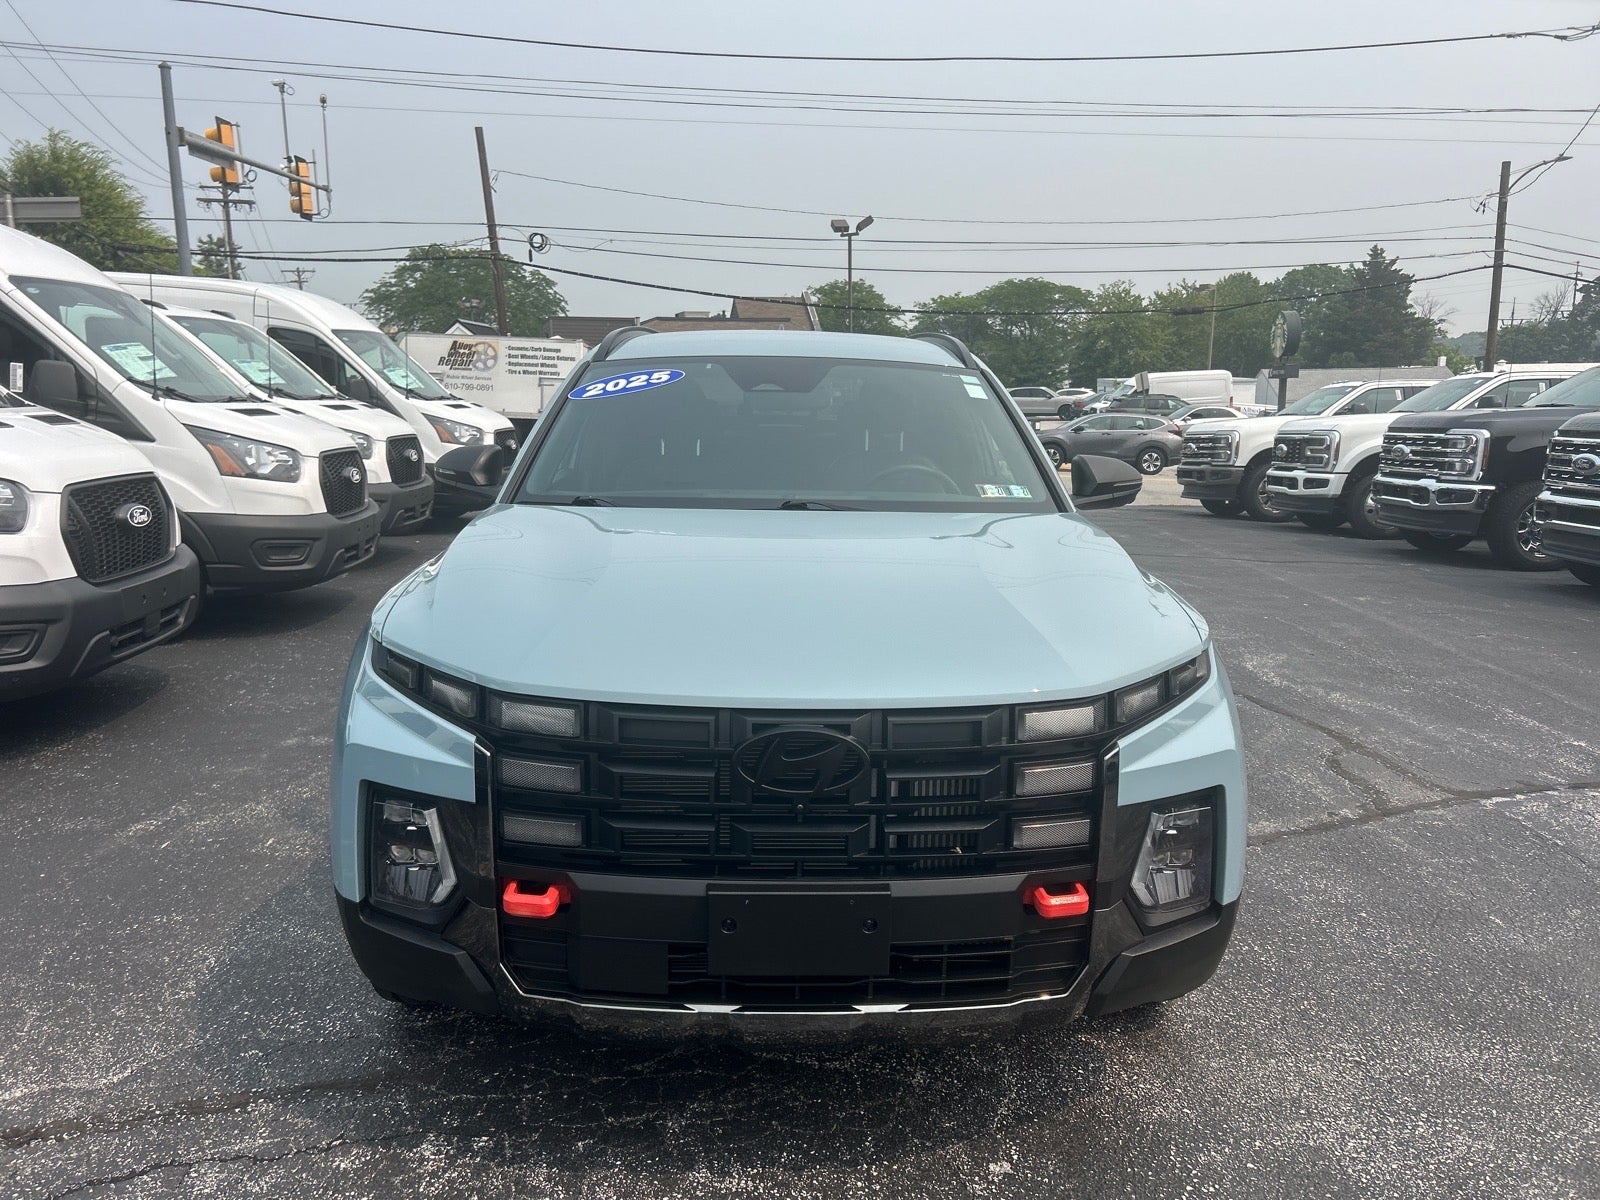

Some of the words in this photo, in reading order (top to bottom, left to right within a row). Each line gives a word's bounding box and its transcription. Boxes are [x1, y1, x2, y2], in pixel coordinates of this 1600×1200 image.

[449, 340, 474, 351] Alloy
[437, 356, 474, 371] Repair
[444, 382, 495, 391] 610-799-0891
[582, 371, 672, 398] 2025
[132, 508, 149, 524] Ford
